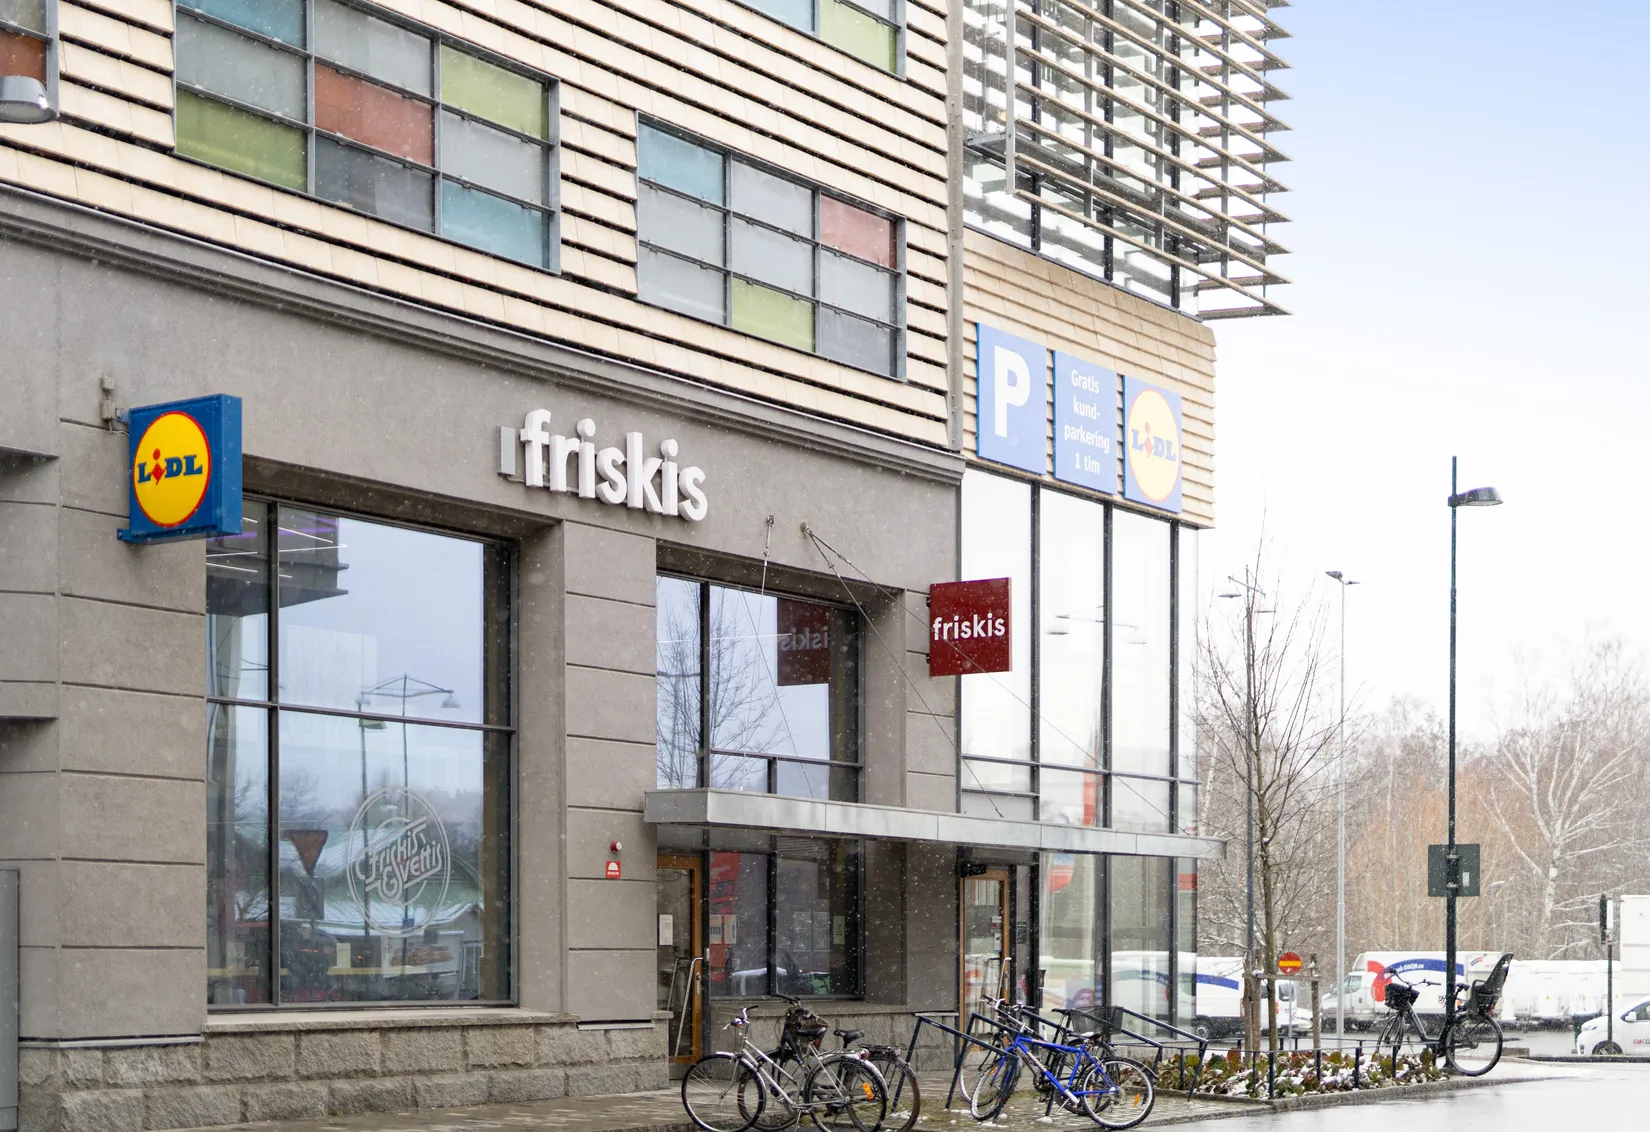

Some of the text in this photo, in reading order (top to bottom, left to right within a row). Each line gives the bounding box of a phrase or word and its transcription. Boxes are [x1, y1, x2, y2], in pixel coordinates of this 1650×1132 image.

[994, 345, 1031, 438] P
[1071, 369, 1100, 393] Gratis
[1073, 396, 1101, 420] kund-
[1064, 424, 1110, 453] parkering
[520, 408, 708, 521] friskis
[1075, 452, 1100, 474] 1 tim
[932, 612, 1006, 640] friskis
